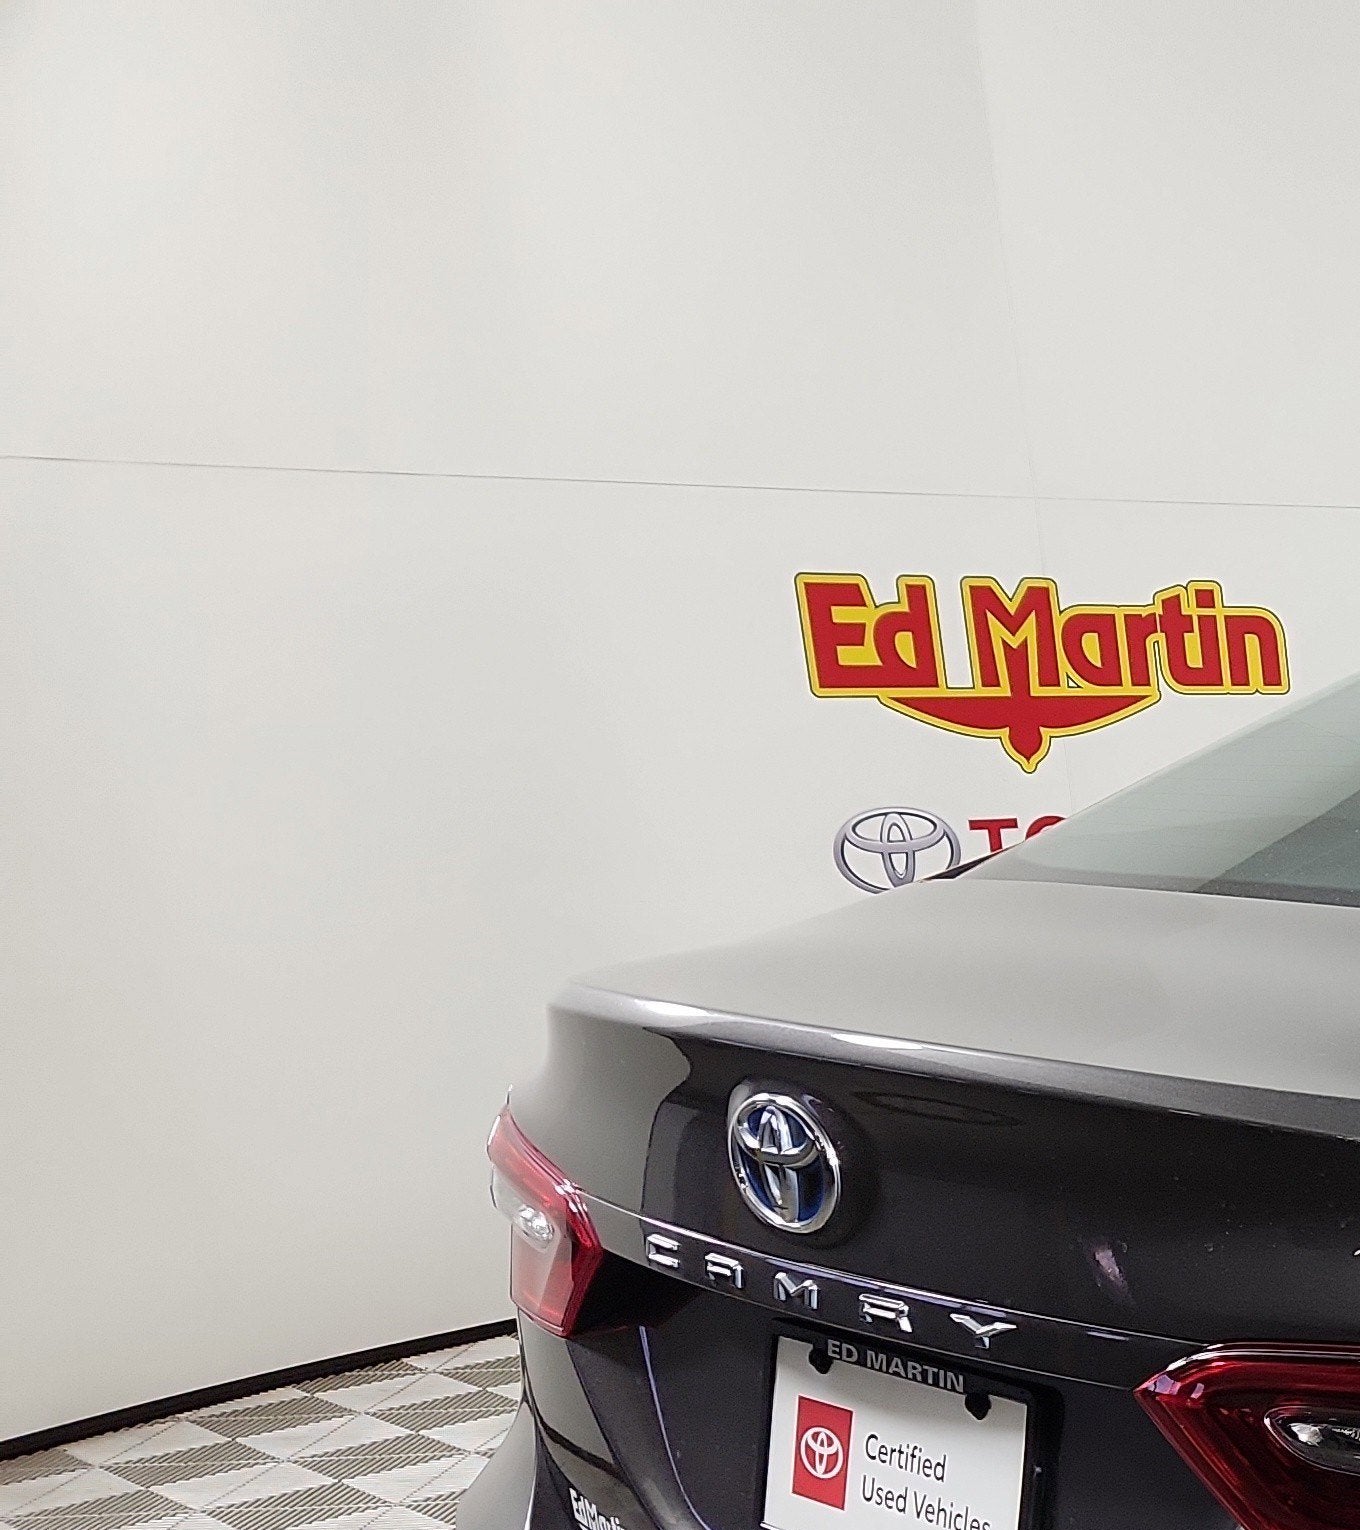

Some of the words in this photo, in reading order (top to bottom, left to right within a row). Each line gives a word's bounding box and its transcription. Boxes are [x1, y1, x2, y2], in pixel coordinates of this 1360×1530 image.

[795, 573, 945, 697] Ed
[961, 576, 1289, 694] Martin
[645, 1232, 1017, 1349] CAMRY
[827, 1339, 861, 1364] ED
[865, 1349, 965, 1394] MARTIN
[864, 1431, 948, 1483] Certified
[861, 1474, 909, 1514] Used
